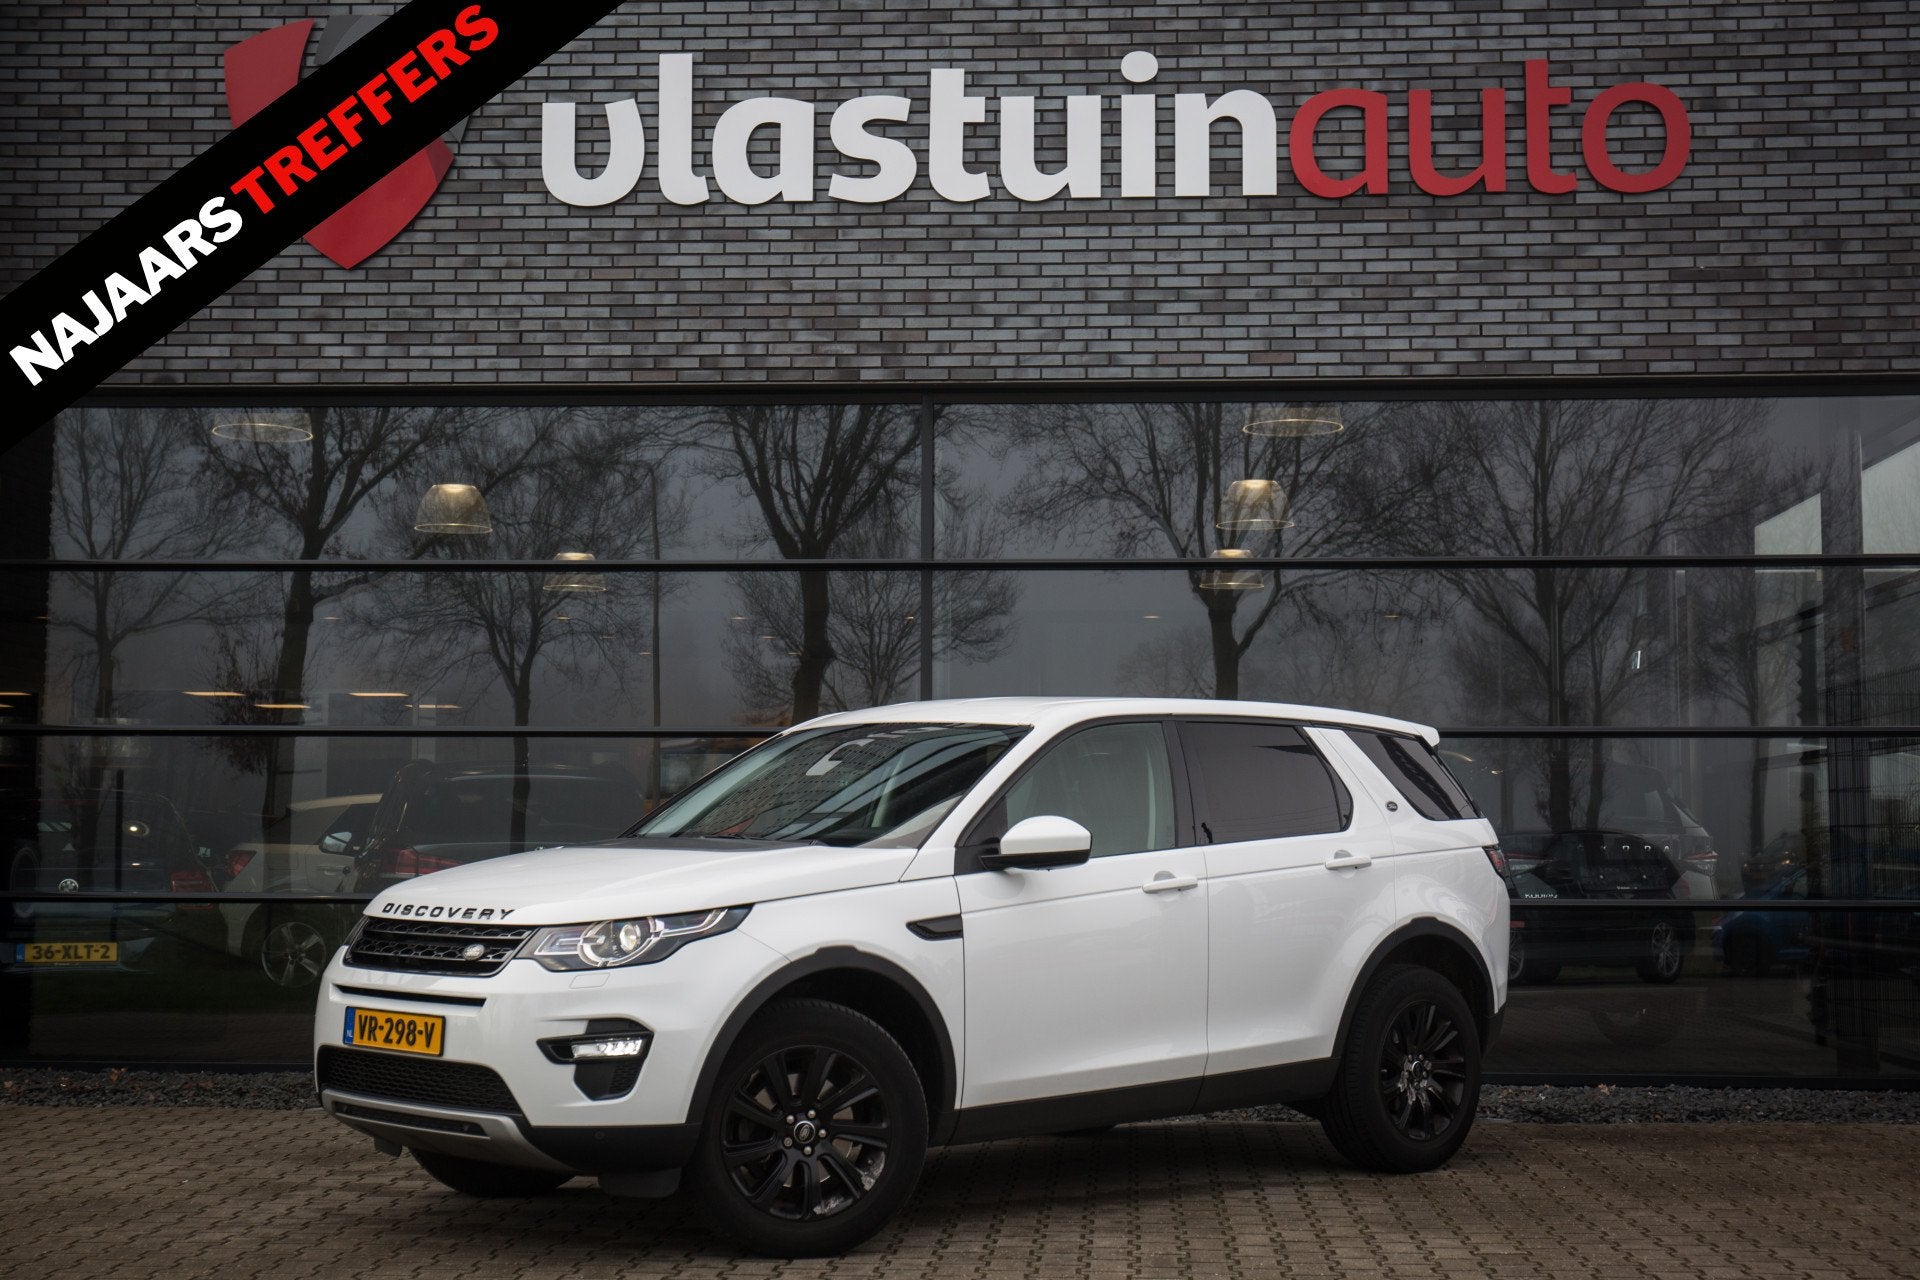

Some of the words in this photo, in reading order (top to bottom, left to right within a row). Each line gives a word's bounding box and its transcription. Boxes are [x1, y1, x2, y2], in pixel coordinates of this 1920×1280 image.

[381, 902, 516, 920] DISCOVERY
[32, 944, 111, 960] 36-XLT-2
[358, 1014, 435, 1048] VR-298-V
